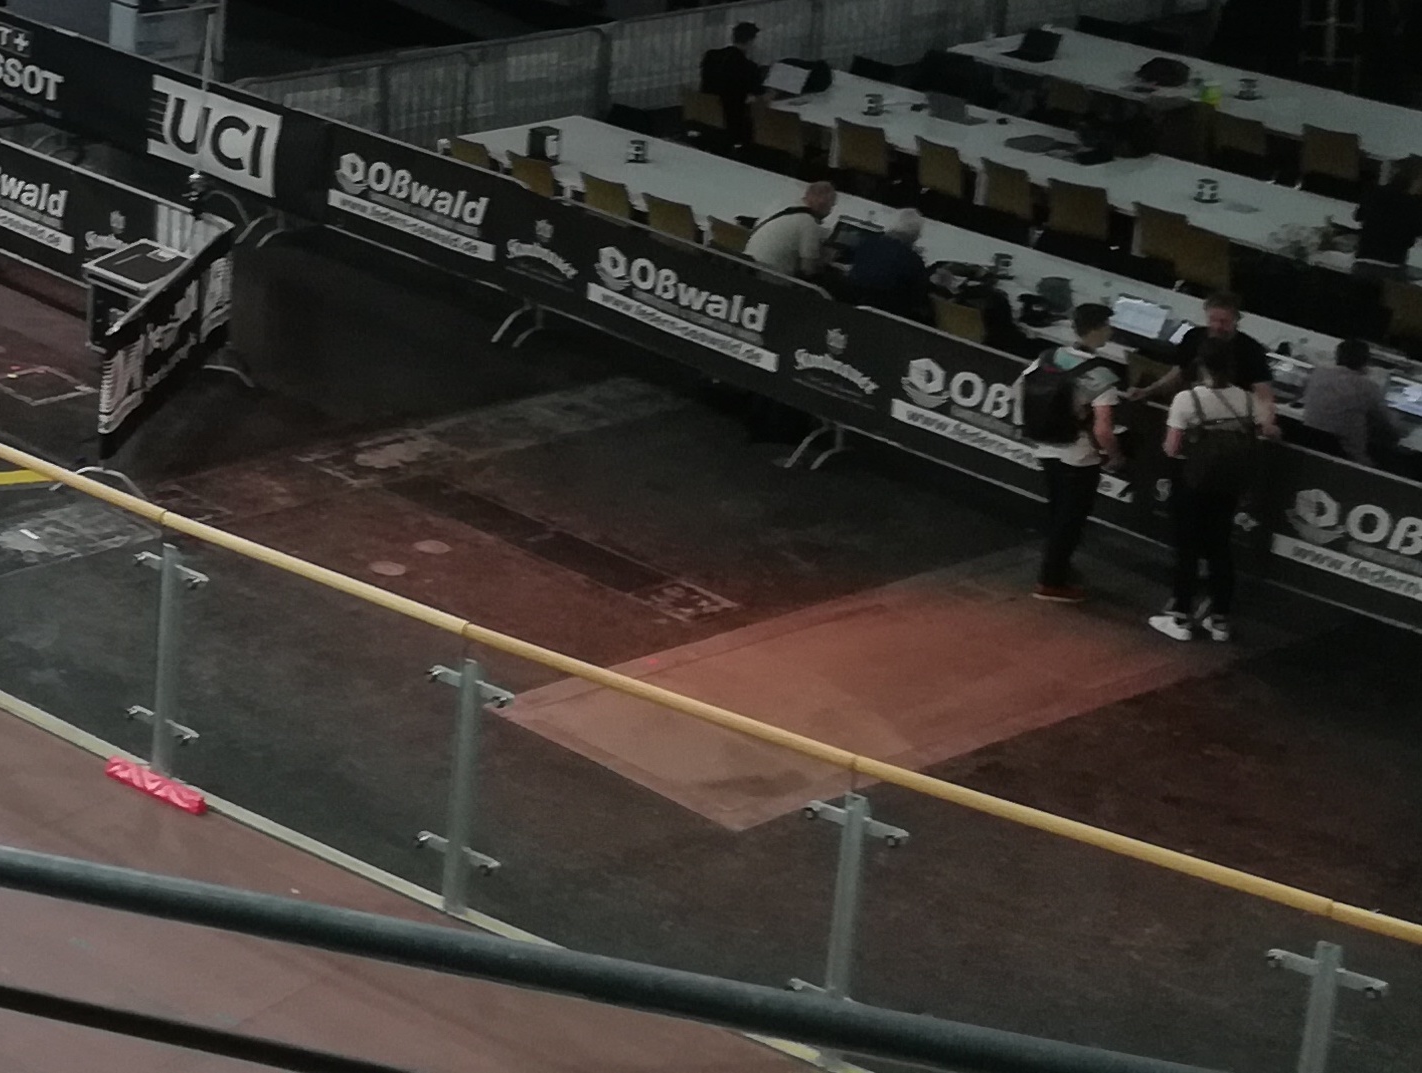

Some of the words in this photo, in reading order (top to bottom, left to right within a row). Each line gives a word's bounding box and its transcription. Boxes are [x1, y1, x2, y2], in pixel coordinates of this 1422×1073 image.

[167, 95, 269, 181] UCI
[368, 161, 490, 226] Oßwald
[630, 257, 770, 333] Oßwald
